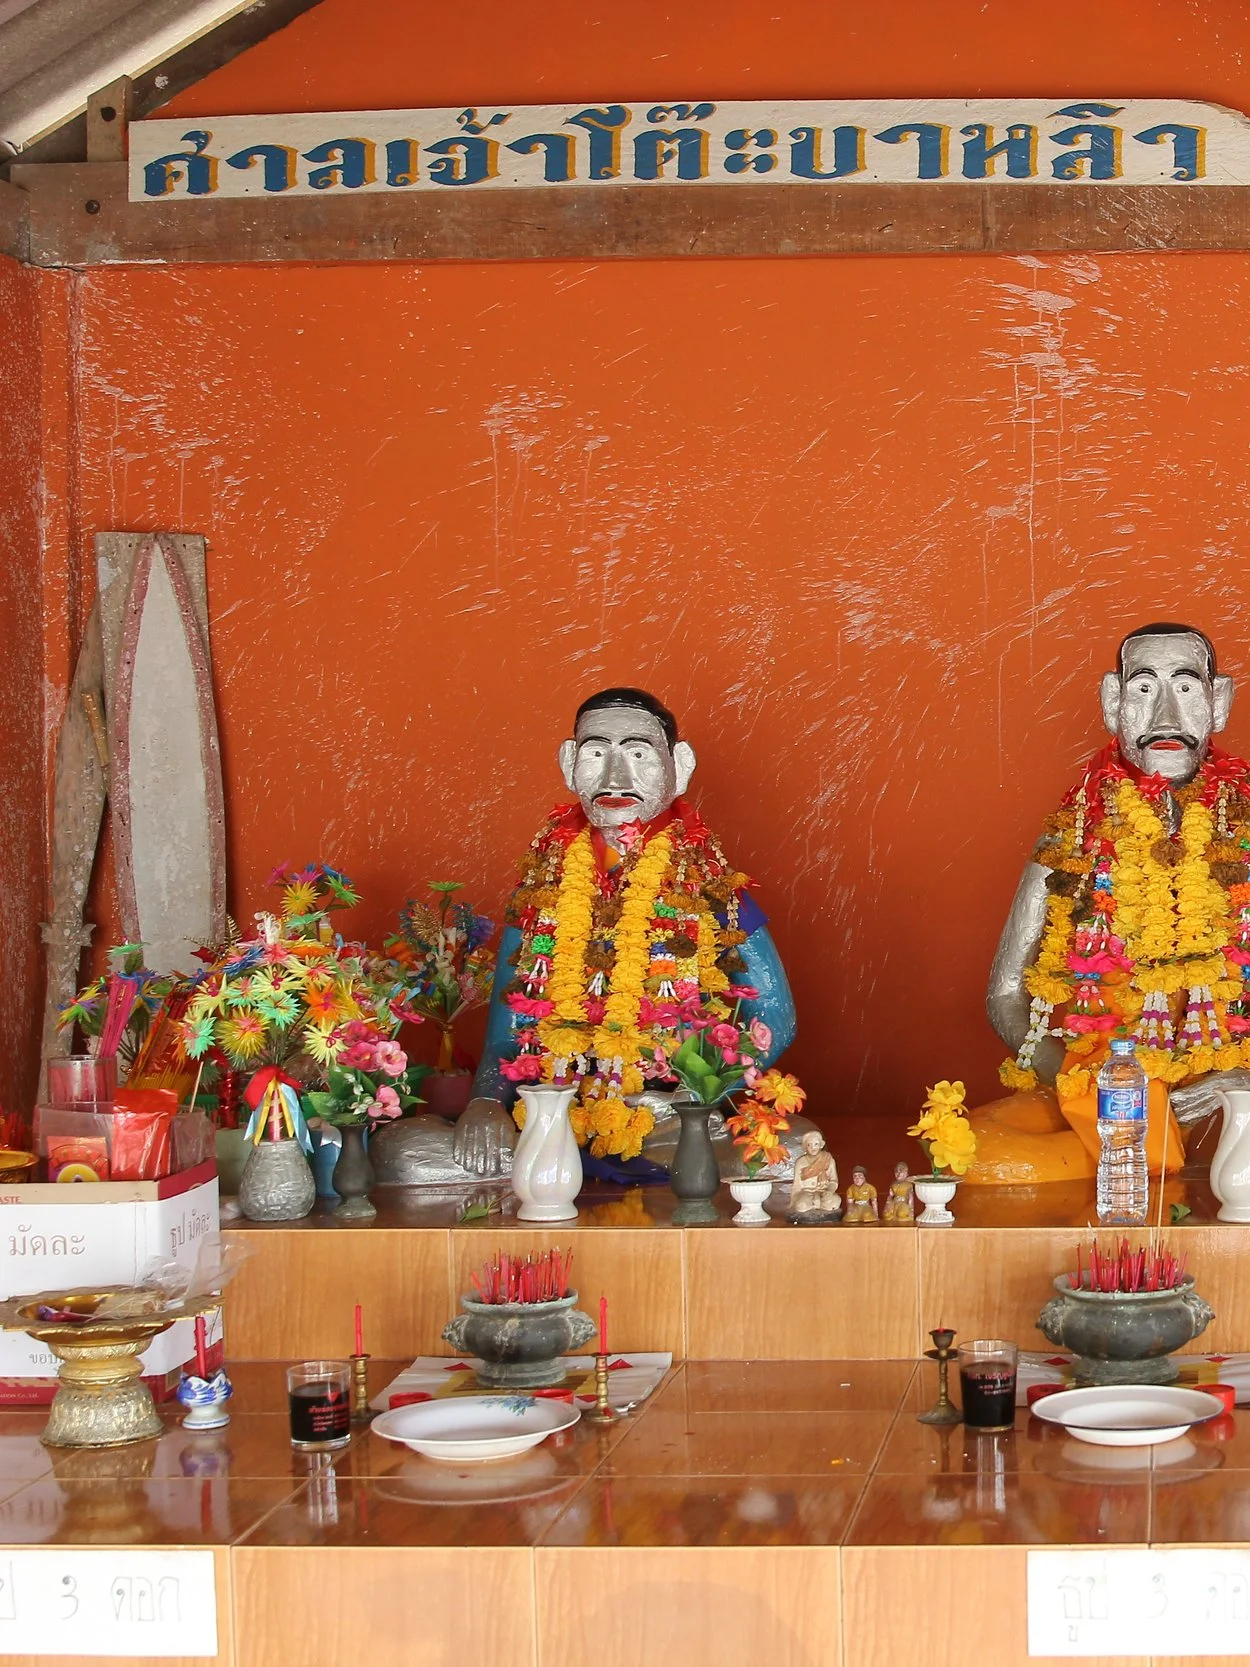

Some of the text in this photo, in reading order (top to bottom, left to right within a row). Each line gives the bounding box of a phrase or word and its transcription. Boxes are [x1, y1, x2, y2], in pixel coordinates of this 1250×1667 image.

[142, 102, 1208, 197] ศาลเจ้าโต๊ะบาหลิว
[8, 1223, 86, 1257] มัดละ
[29, 1353, 63, 1365] ขอบ
[110, 1576, 182, 1622] ดอก
